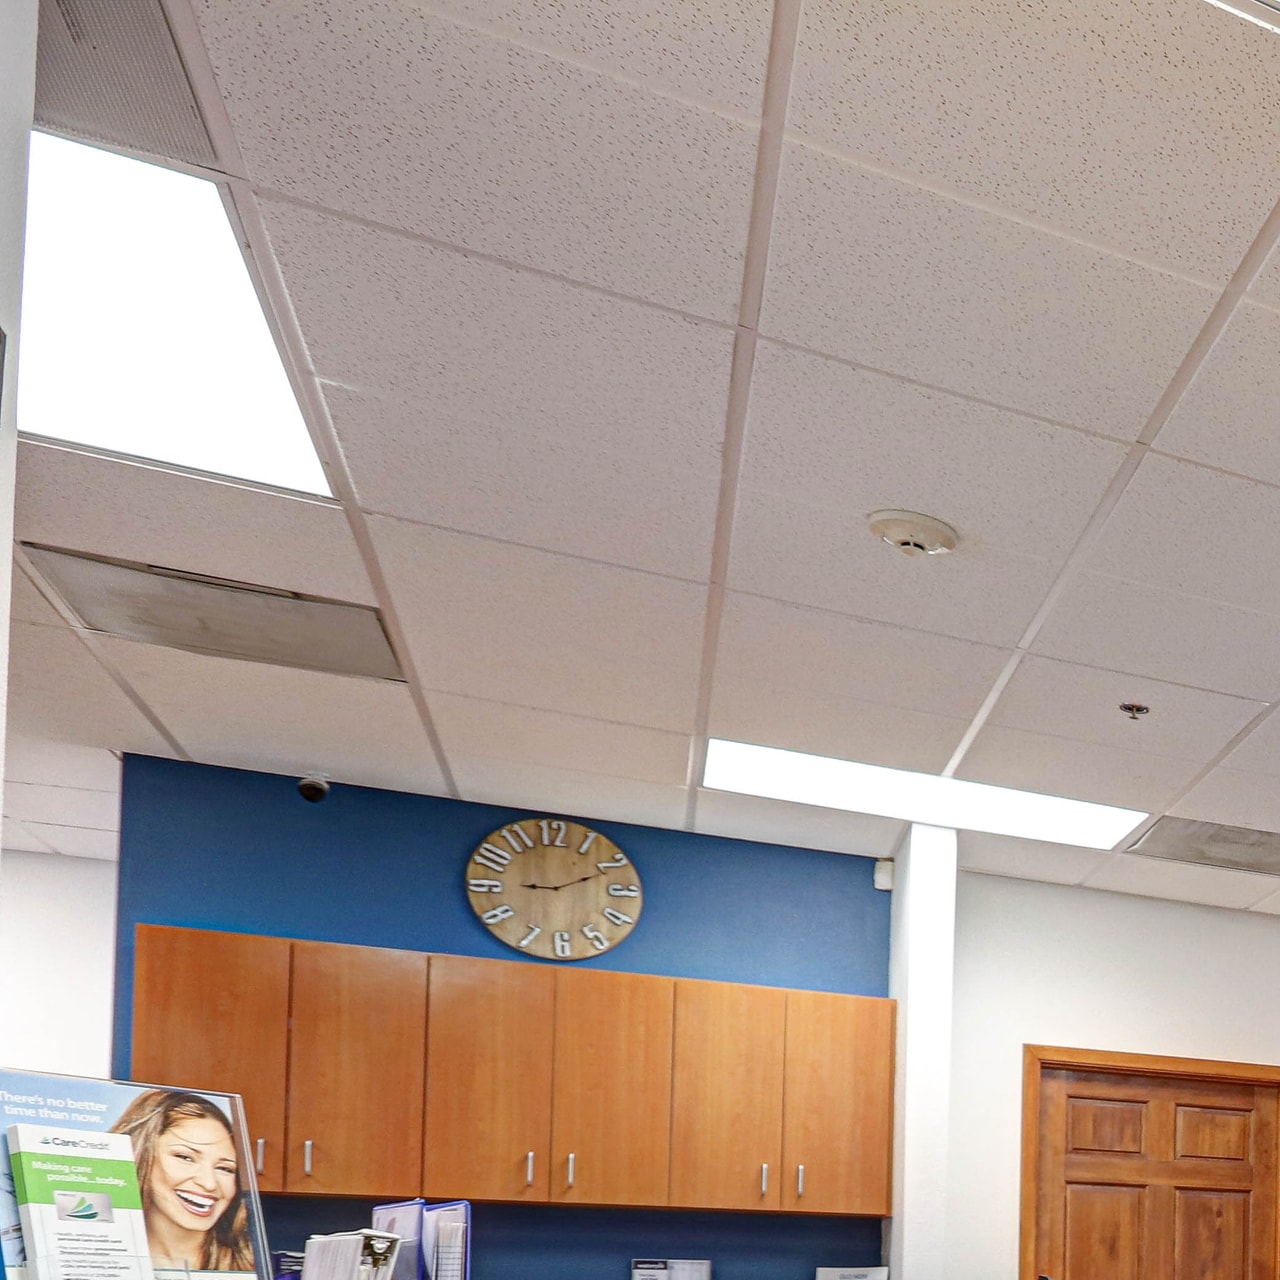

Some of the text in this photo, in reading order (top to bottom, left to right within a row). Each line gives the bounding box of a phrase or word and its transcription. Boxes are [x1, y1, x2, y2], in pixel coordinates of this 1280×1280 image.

[501, 824, 534, 853] 11
[538, 819, 568, 847] 12
[578, 831, 598, 854] 1
[473, 843, 512, 873] 10
[597, 853, 628, 874] 2
[468, 879, 502, 893] 9
[608, 884, 639, 897] 3
[482, 904, 515, 925] 8
[604, 907, 633, 925] 4
[518, 924, 542, 948] 7
[553, 931, 571, 957] 6
[582, 923, 610, 950] 5
[4, 1104, 37, 1117] time
[38, 1107, 69, 1120] than
[47, 1098, 65, 1108] no
[66, 1097, 109, 1112] better
[51, 1137, 110, 1150] CareCredit
